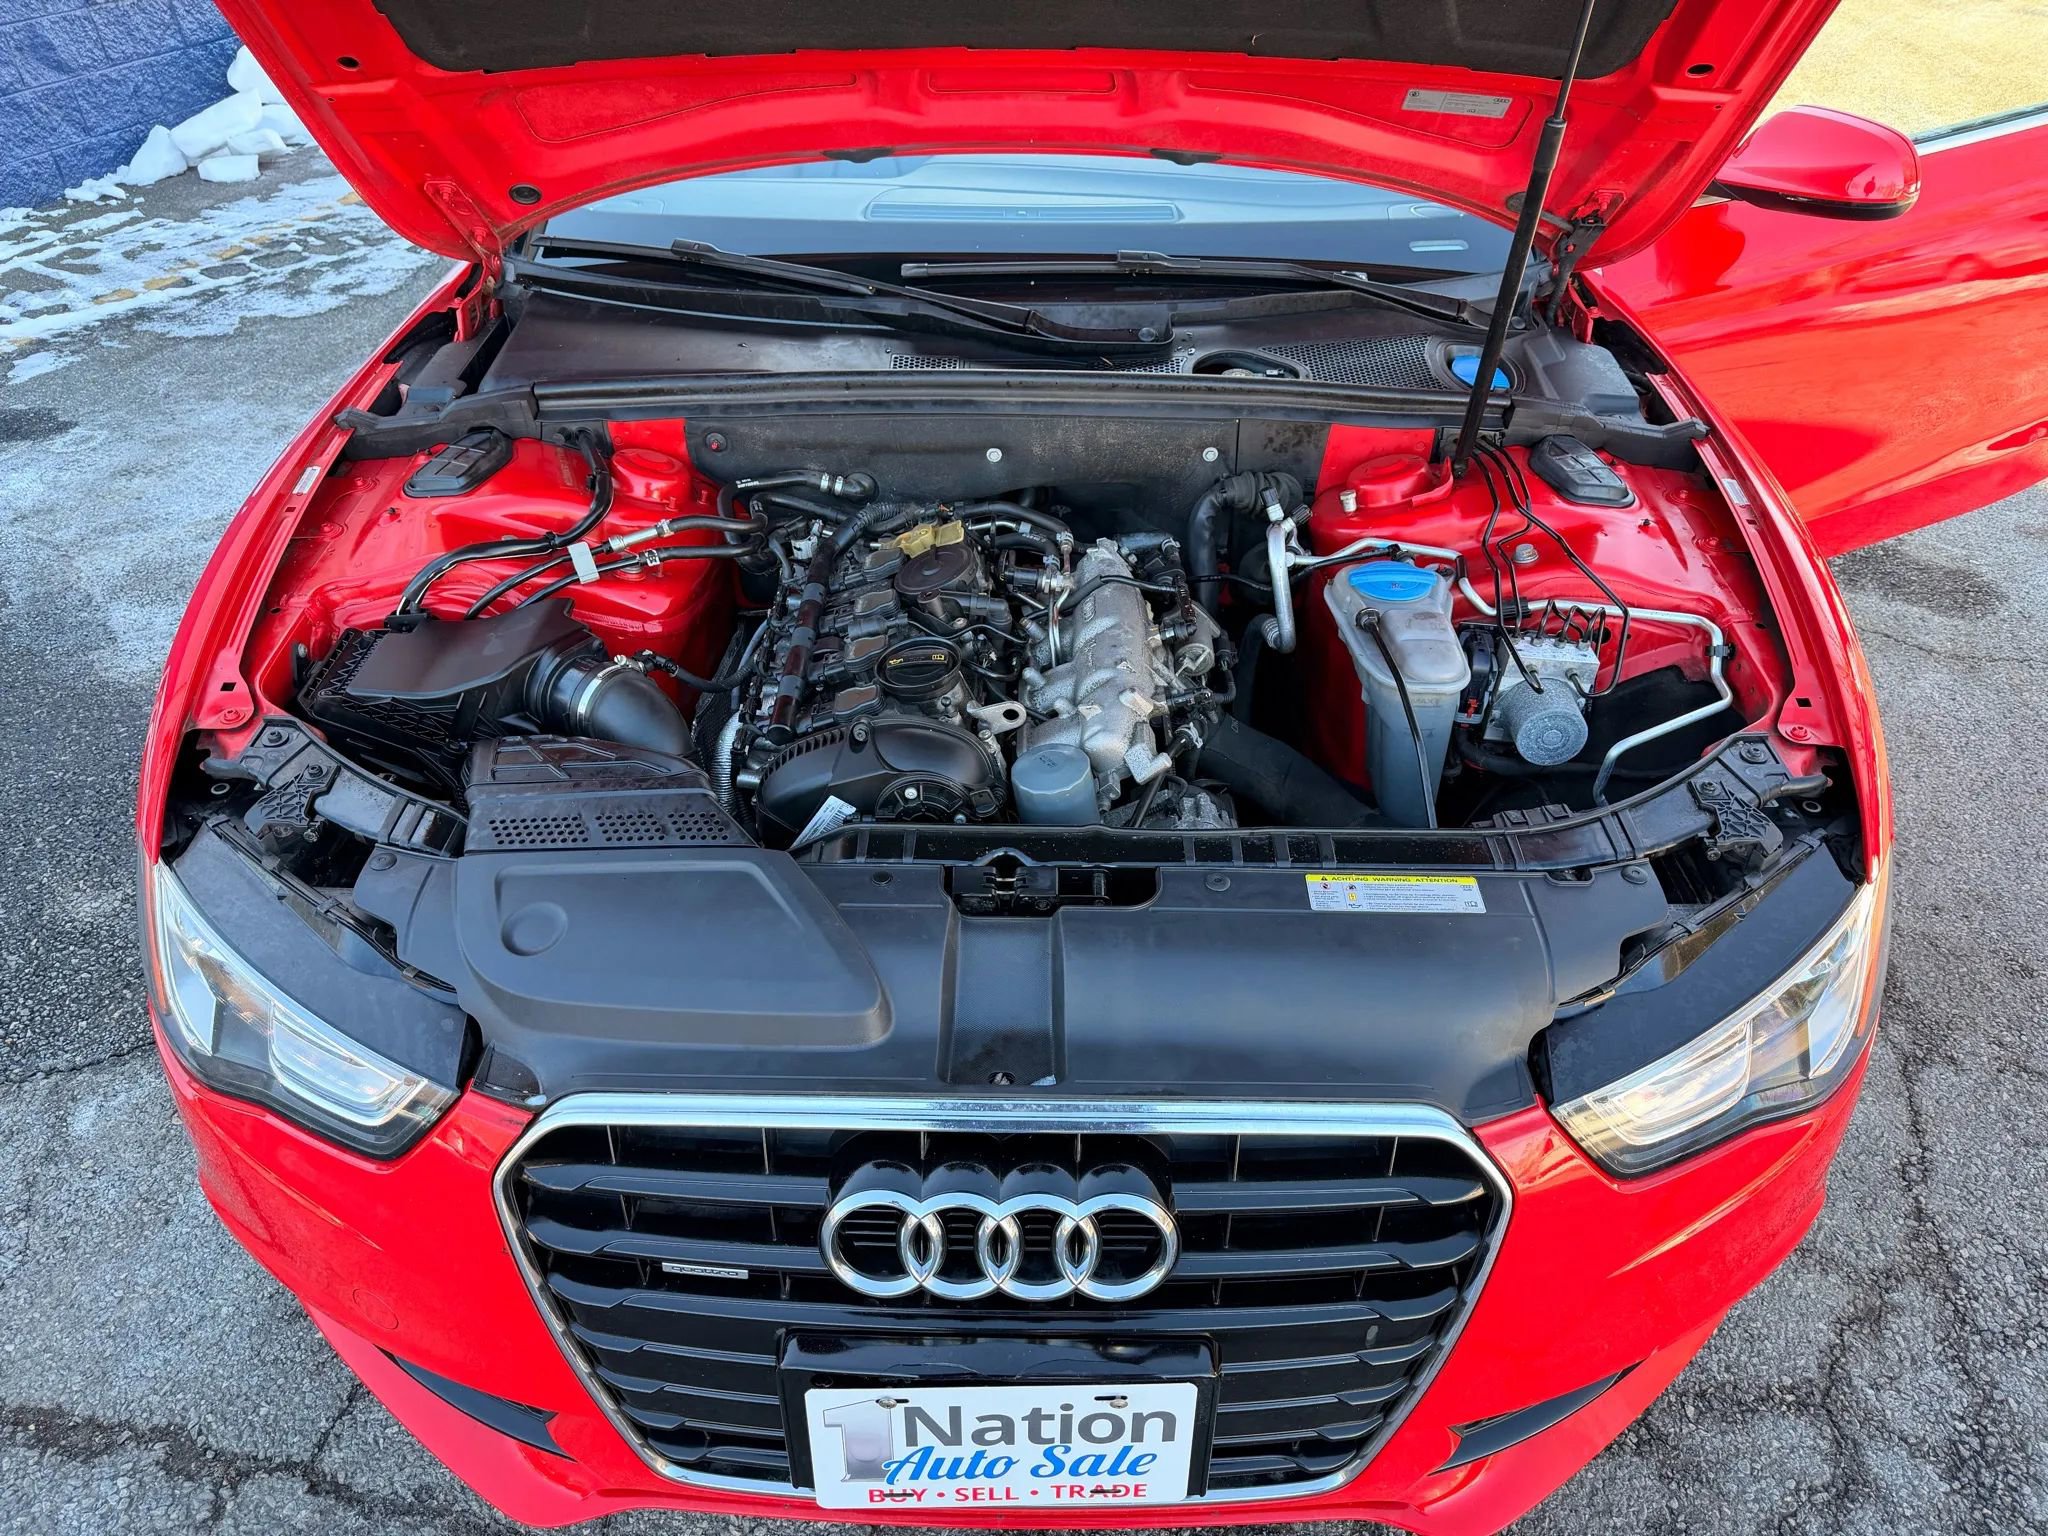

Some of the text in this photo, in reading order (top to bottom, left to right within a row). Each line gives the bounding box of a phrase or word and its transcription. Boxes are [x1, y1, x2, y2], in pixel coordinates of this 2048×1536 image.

[903, 1403, 1177, 1447] Nation
[882, 1444, 1158, 1486] Auto Sale
[868, 1483, 1147, 1504] BUY SELL TRADE
